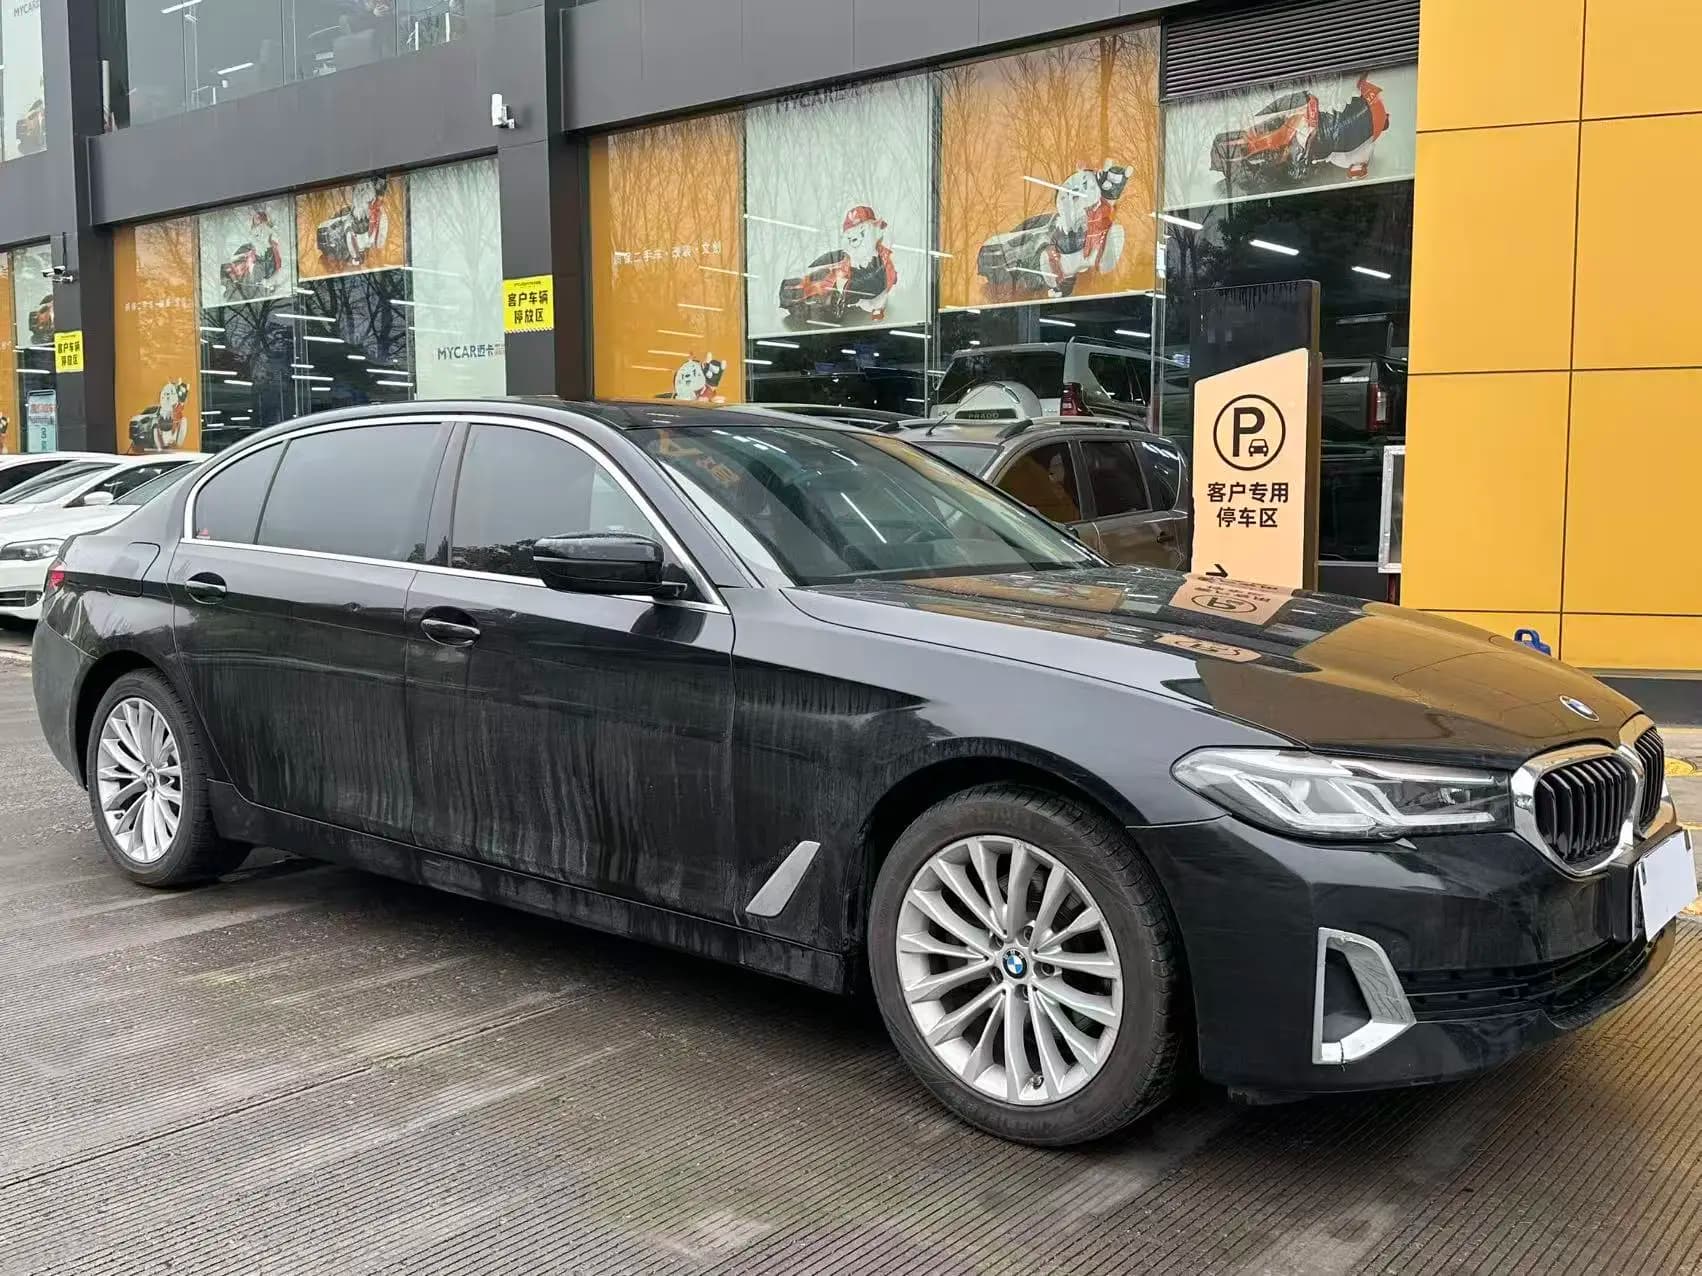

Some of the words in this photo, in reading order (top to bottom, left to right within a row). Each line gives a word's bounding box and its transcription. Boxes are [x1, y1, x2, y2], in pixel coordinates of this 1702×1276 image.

[508, 290, 549, 307] 客户车辆
[514, 308, 544, 324] 停放区
[1232, 406, 1265, 457] P
[1206, 481, 1290, 504] 客户专用
[1216, 506, 1279, 529] 停车区
